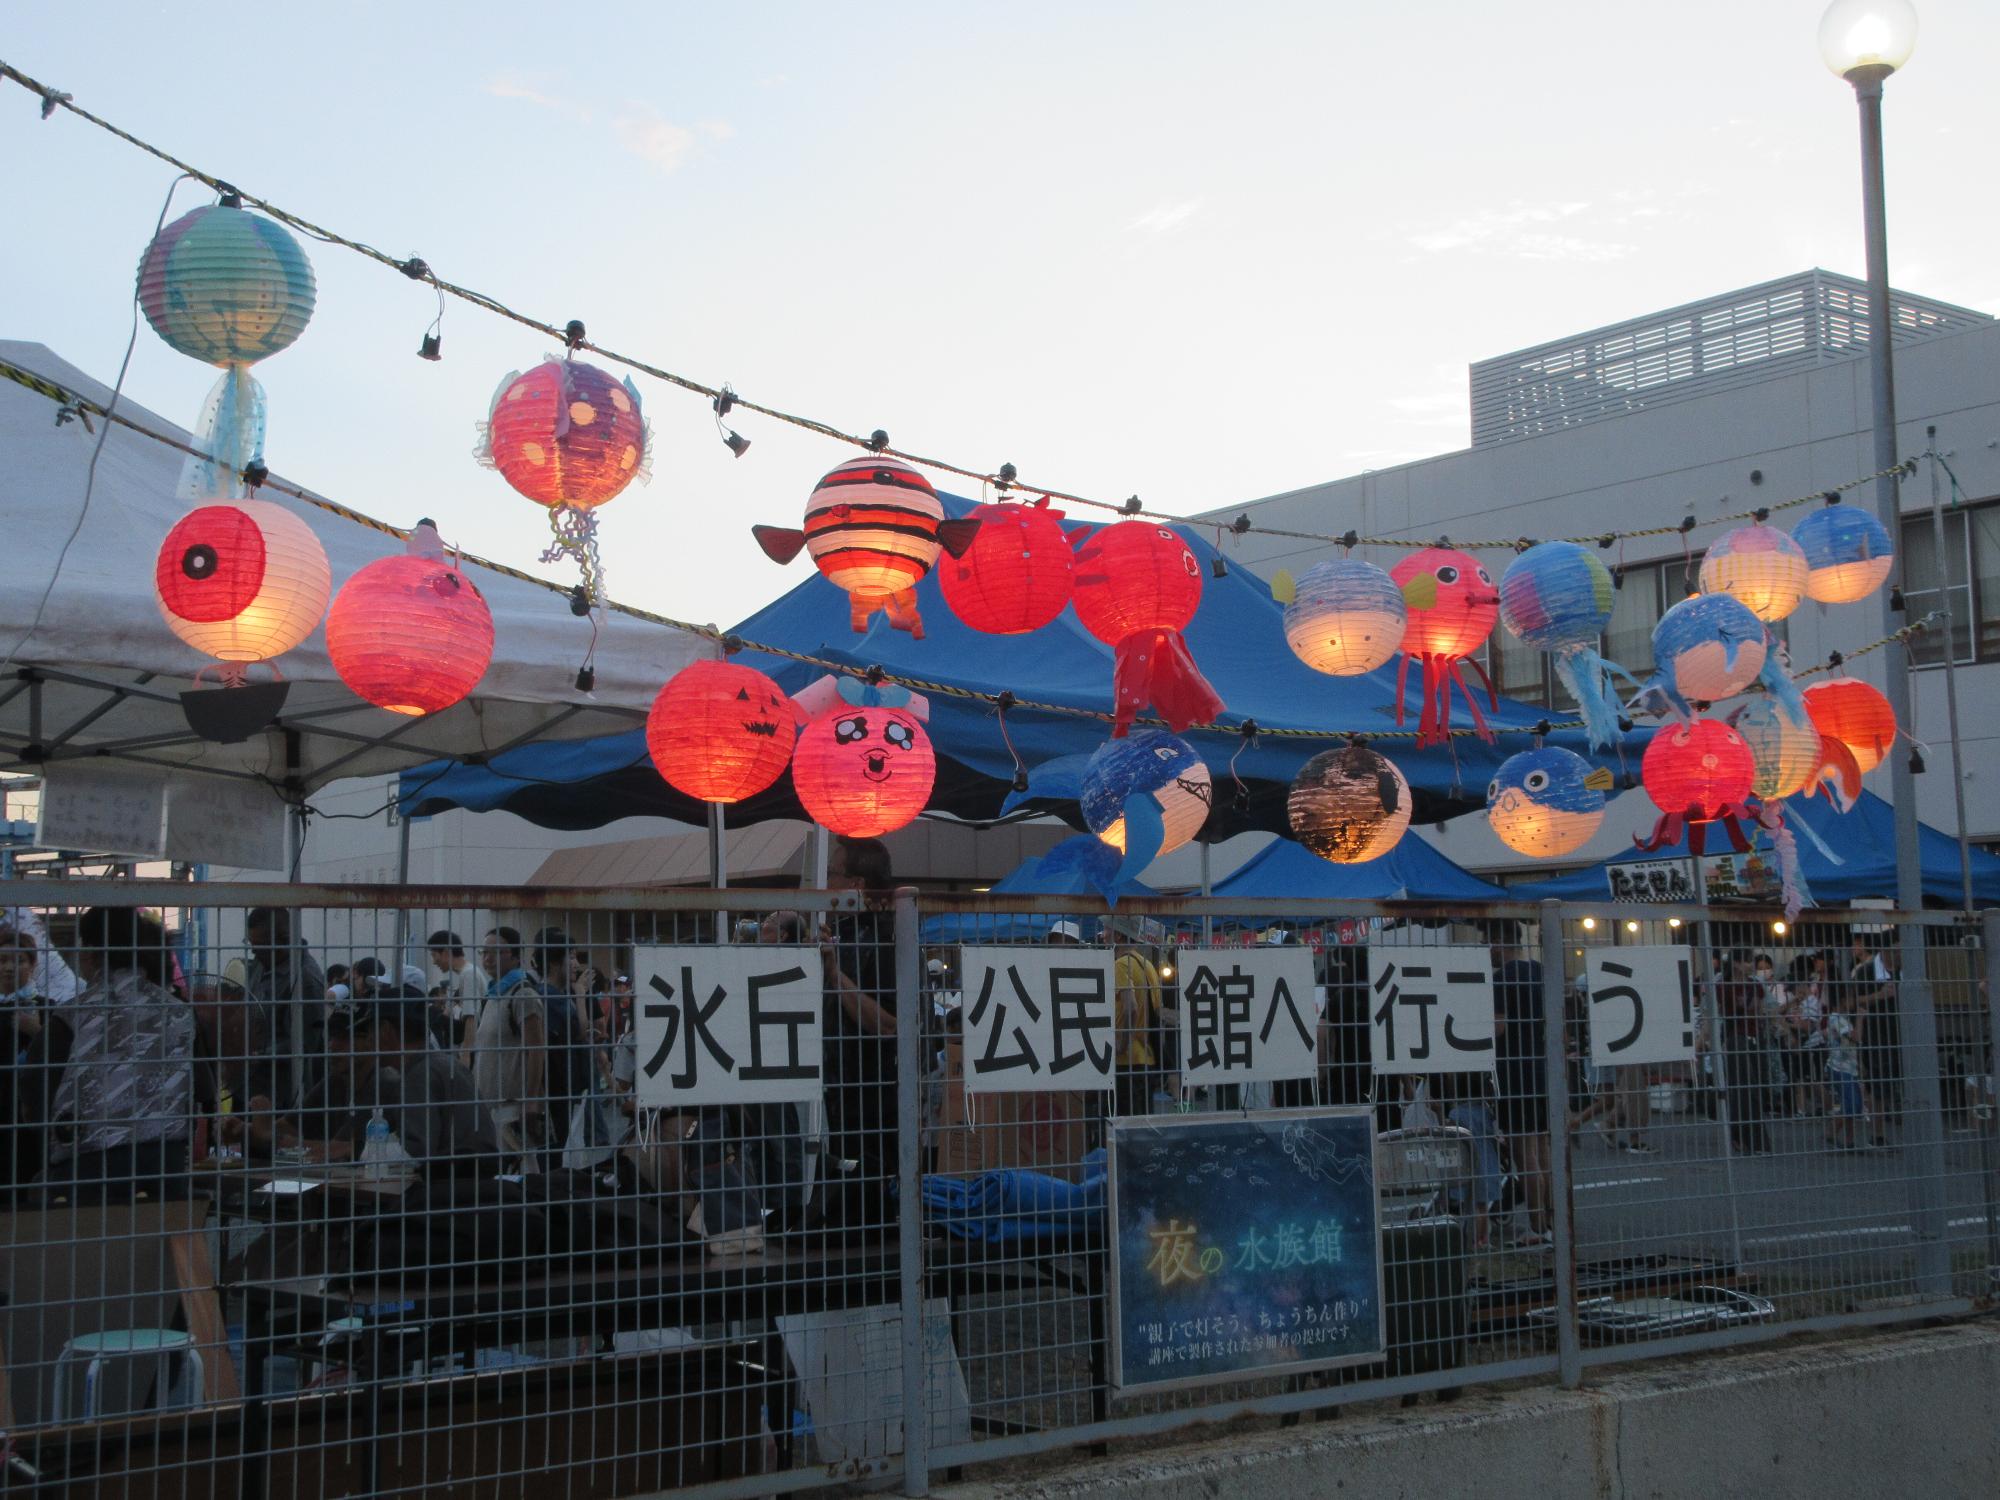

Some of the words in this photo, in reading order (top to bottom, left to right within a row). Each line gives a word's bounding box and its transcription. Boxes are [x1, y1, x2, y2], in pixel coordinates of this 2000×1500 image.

[1610, 868, 1689, 896] たこせん
[643, 965, 820, 1090] 氷丘
[968, 964, 1113, 1076] 公民
[1184, 964, 1315, 1070] 館へ
[1374, 962, 1493, 1061] 行こ
